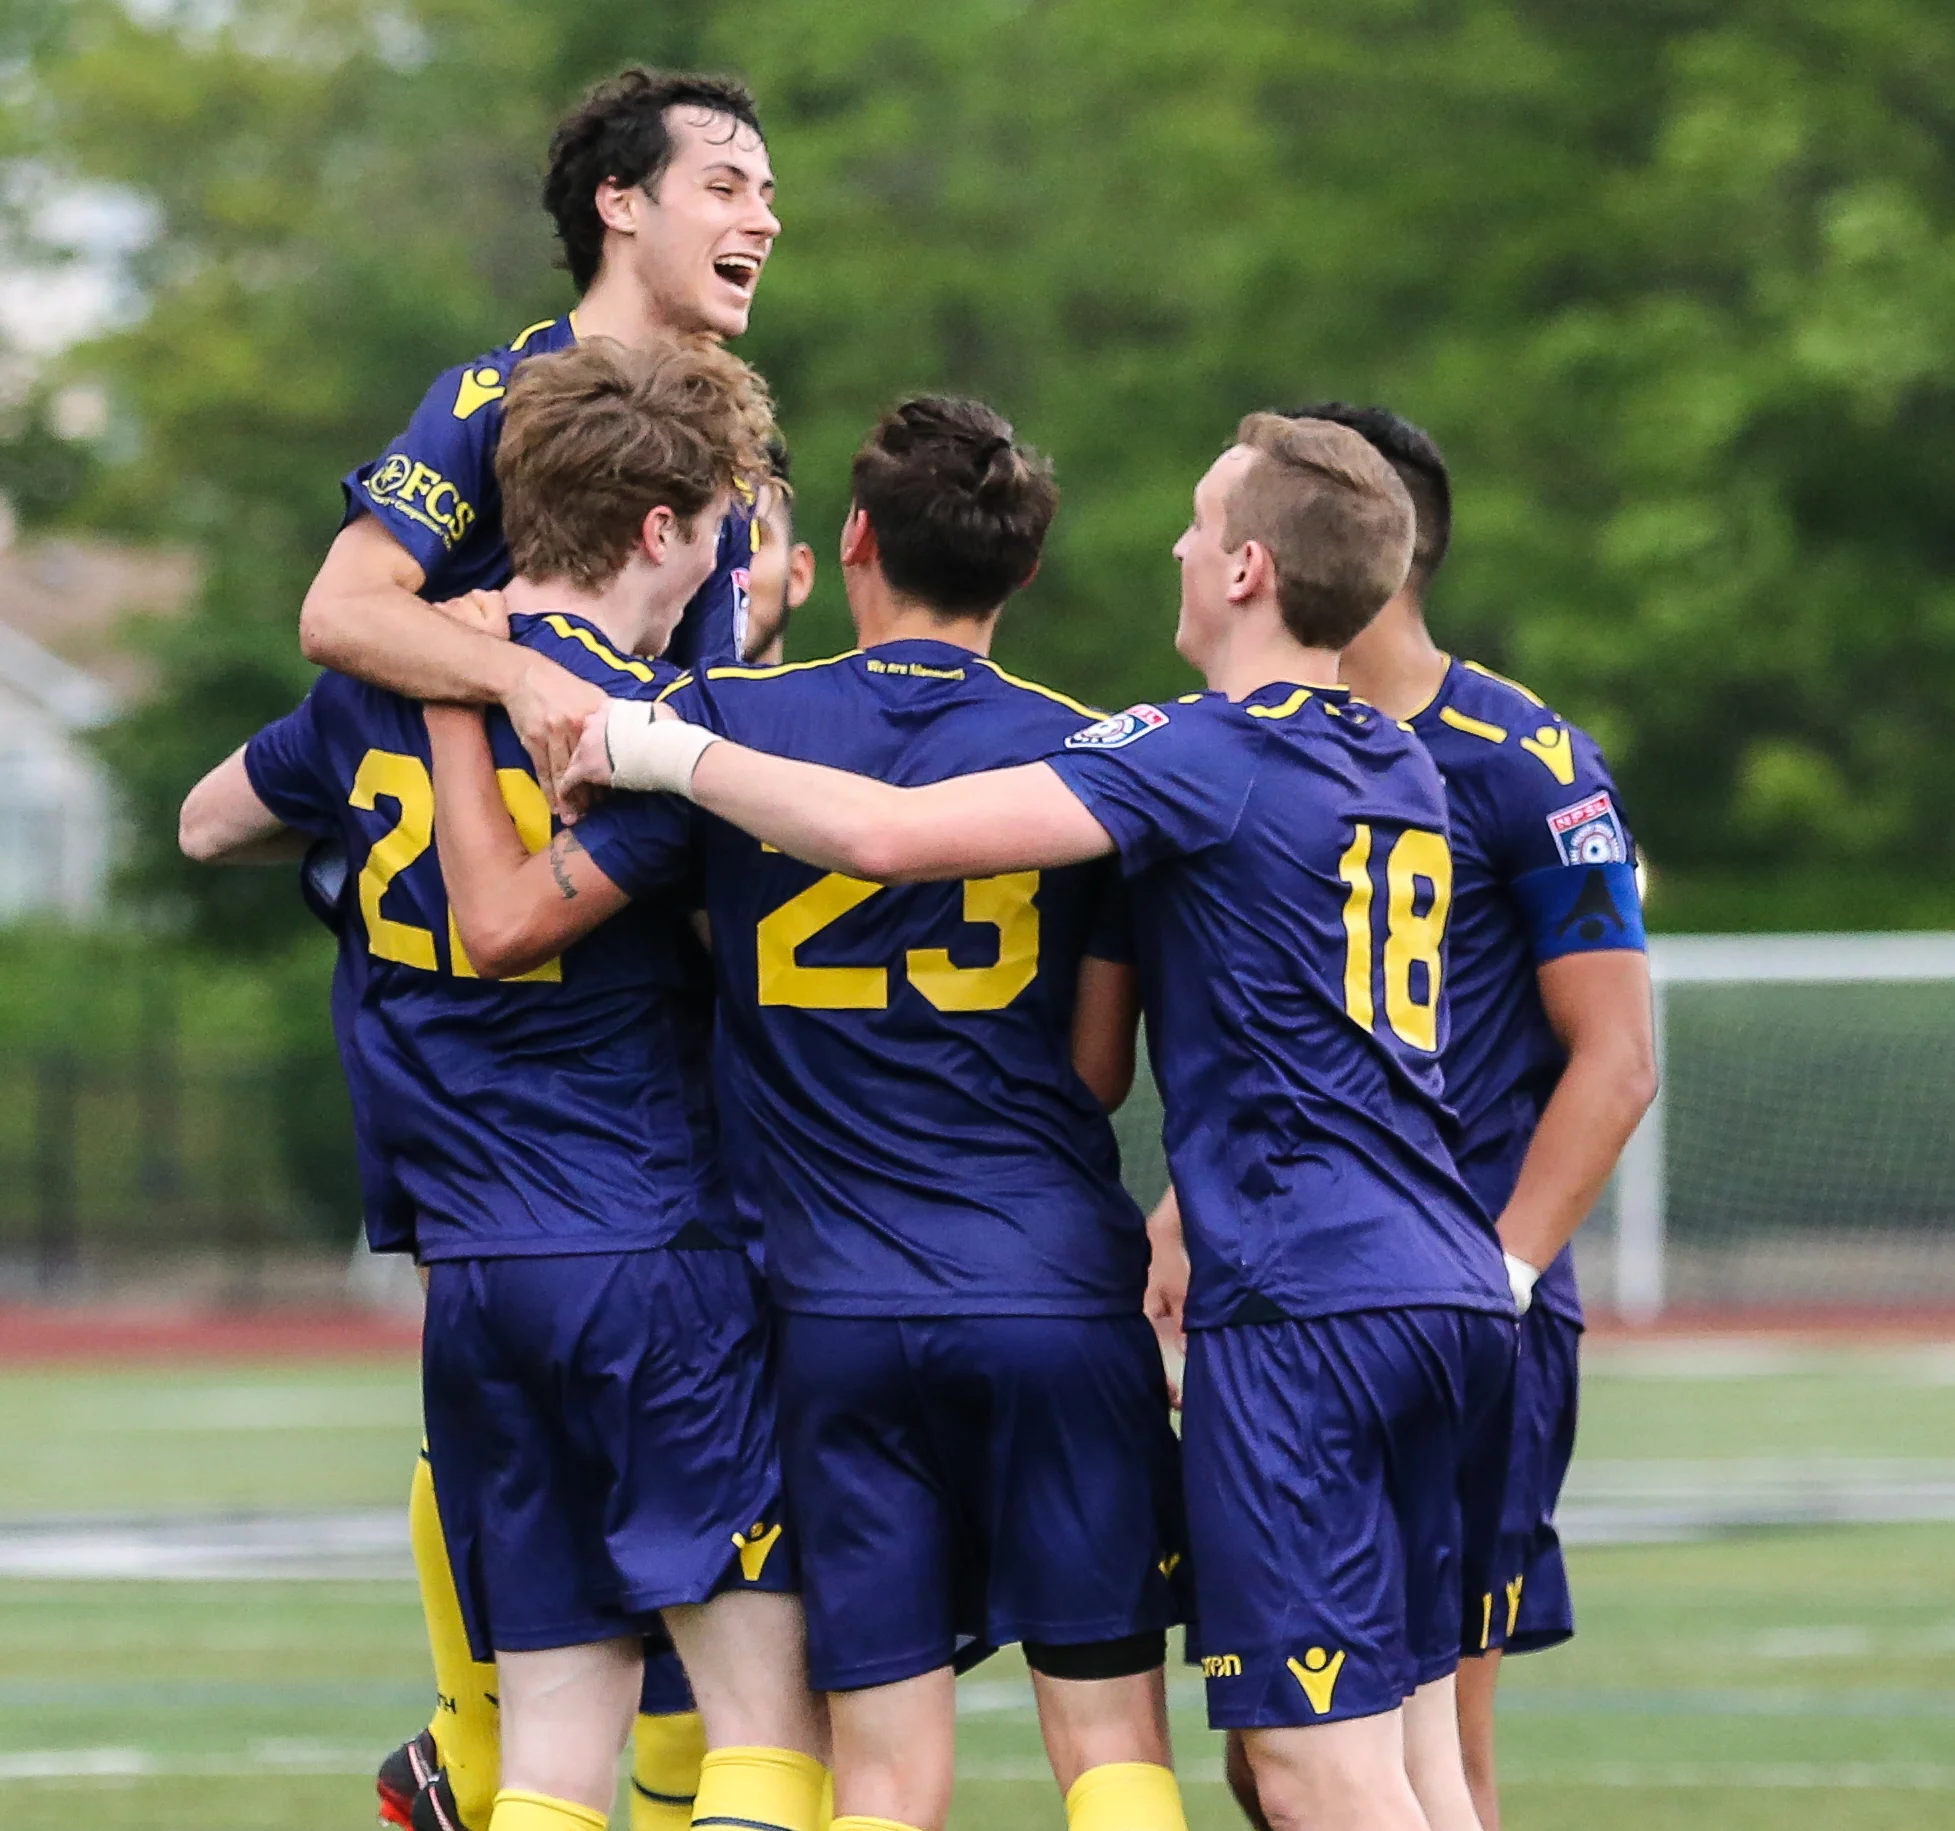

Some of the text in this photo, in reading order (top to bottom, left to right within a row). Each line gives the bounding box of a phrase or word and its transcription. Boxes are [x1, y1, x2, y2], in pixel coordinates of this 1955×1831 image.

[397, 461, 476, 541] FCS
[757, 842, 1040, 1012] 23
[1338, 823, 1453, 1052] 18
